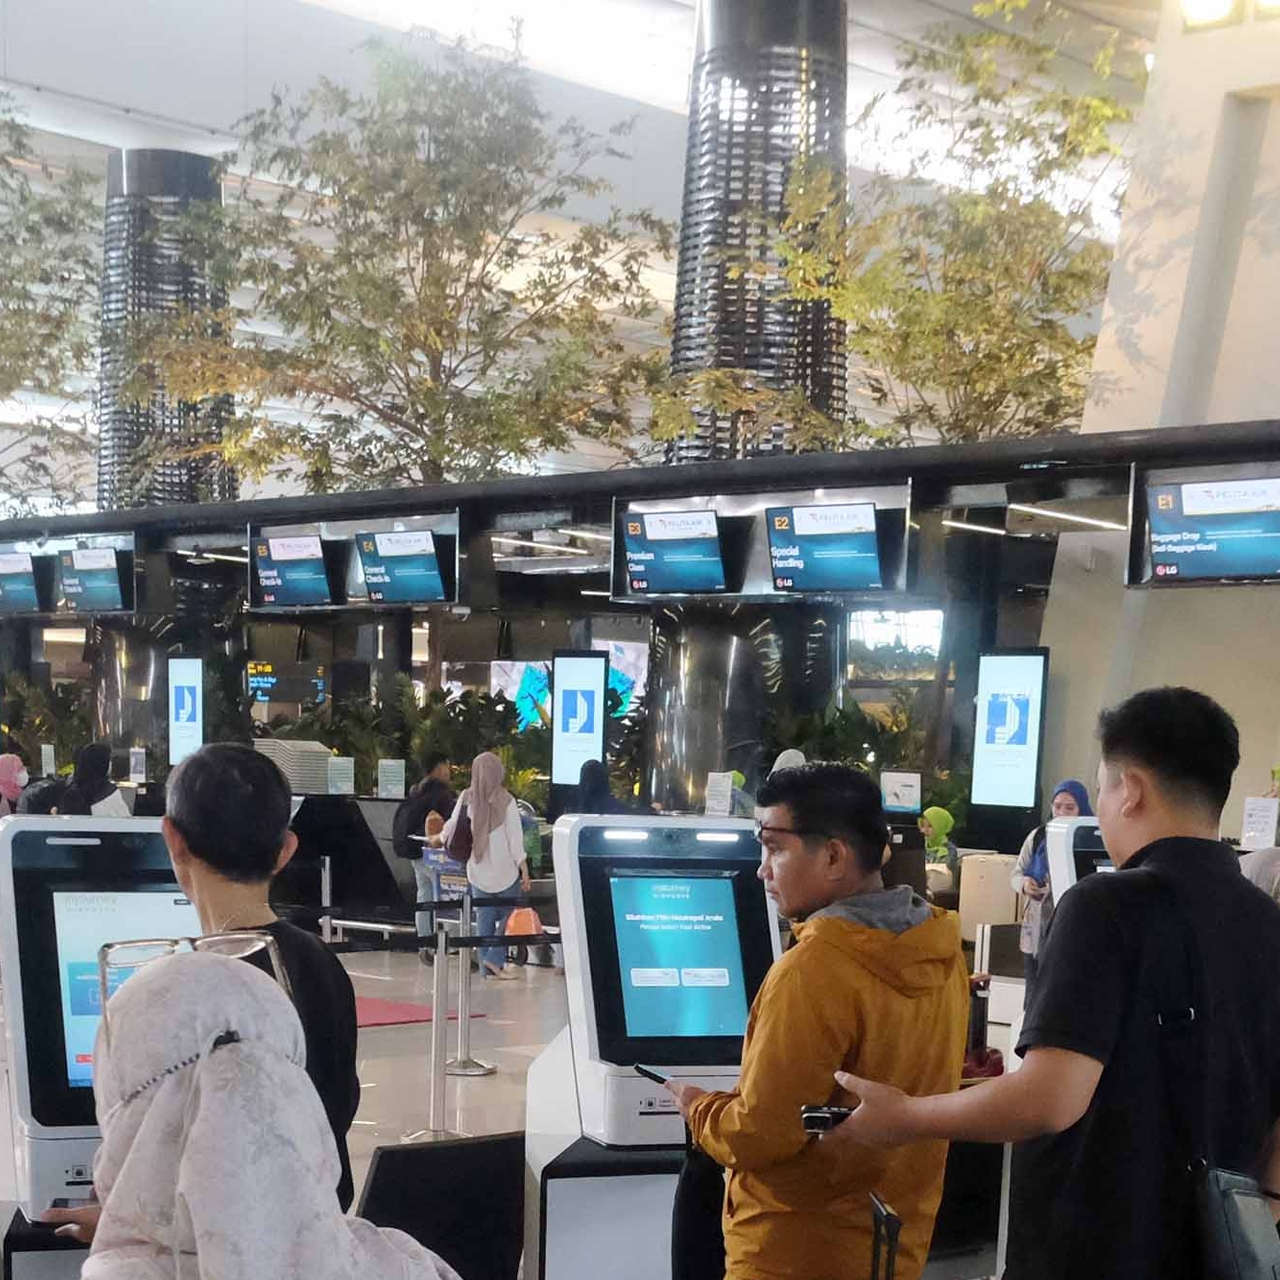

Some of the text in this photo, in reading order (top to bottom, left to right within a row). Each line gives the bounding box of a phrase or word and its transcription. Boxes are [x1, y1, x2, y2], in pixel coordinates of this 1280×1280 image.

[774, 516, 790, 530] E2
[626, 550, 655, 561] Premium
[771, 545, 800, 557] Special
[772, 558, 804, 569] Handling
[1166, 565, 1178, 575] LG
[784, 579, 793, 587] LG
